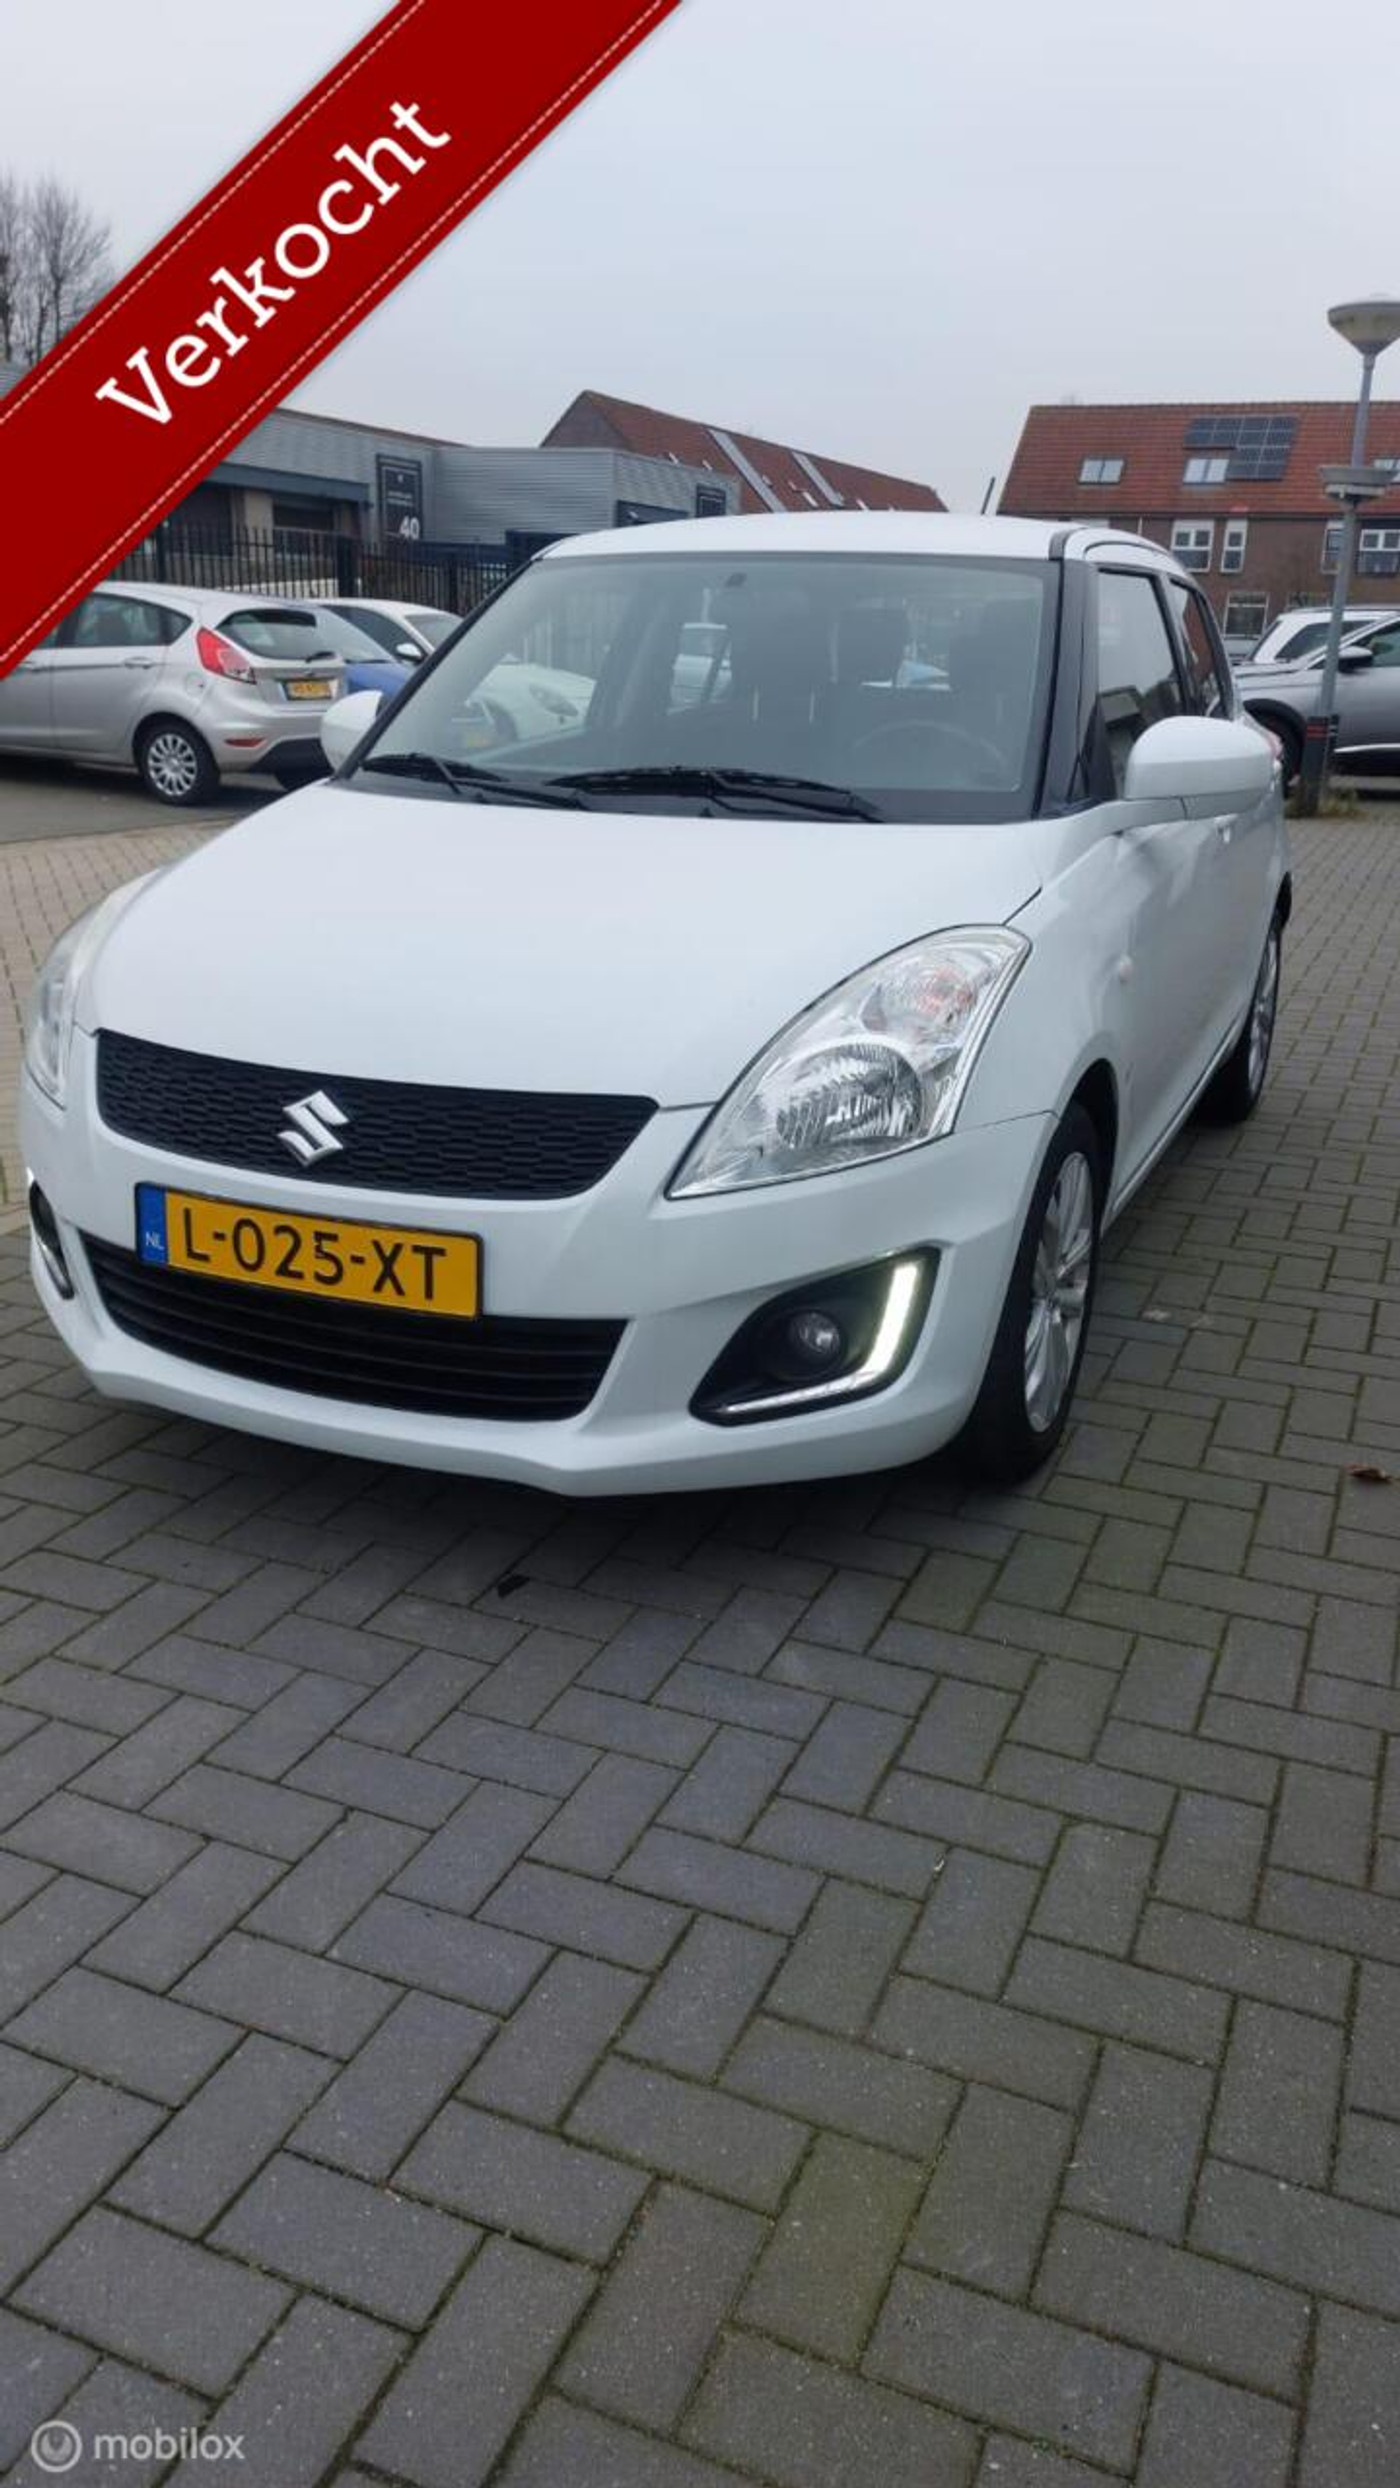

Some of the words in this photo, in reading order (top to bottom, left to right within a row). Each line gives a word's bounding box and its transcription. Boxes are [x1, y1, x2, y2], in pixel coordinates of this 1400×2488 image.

[399, 515, 420, 540] 40
[145, 1230, 164, 1251] NL
[183, 1208, 446, 1300] L-025-XT
